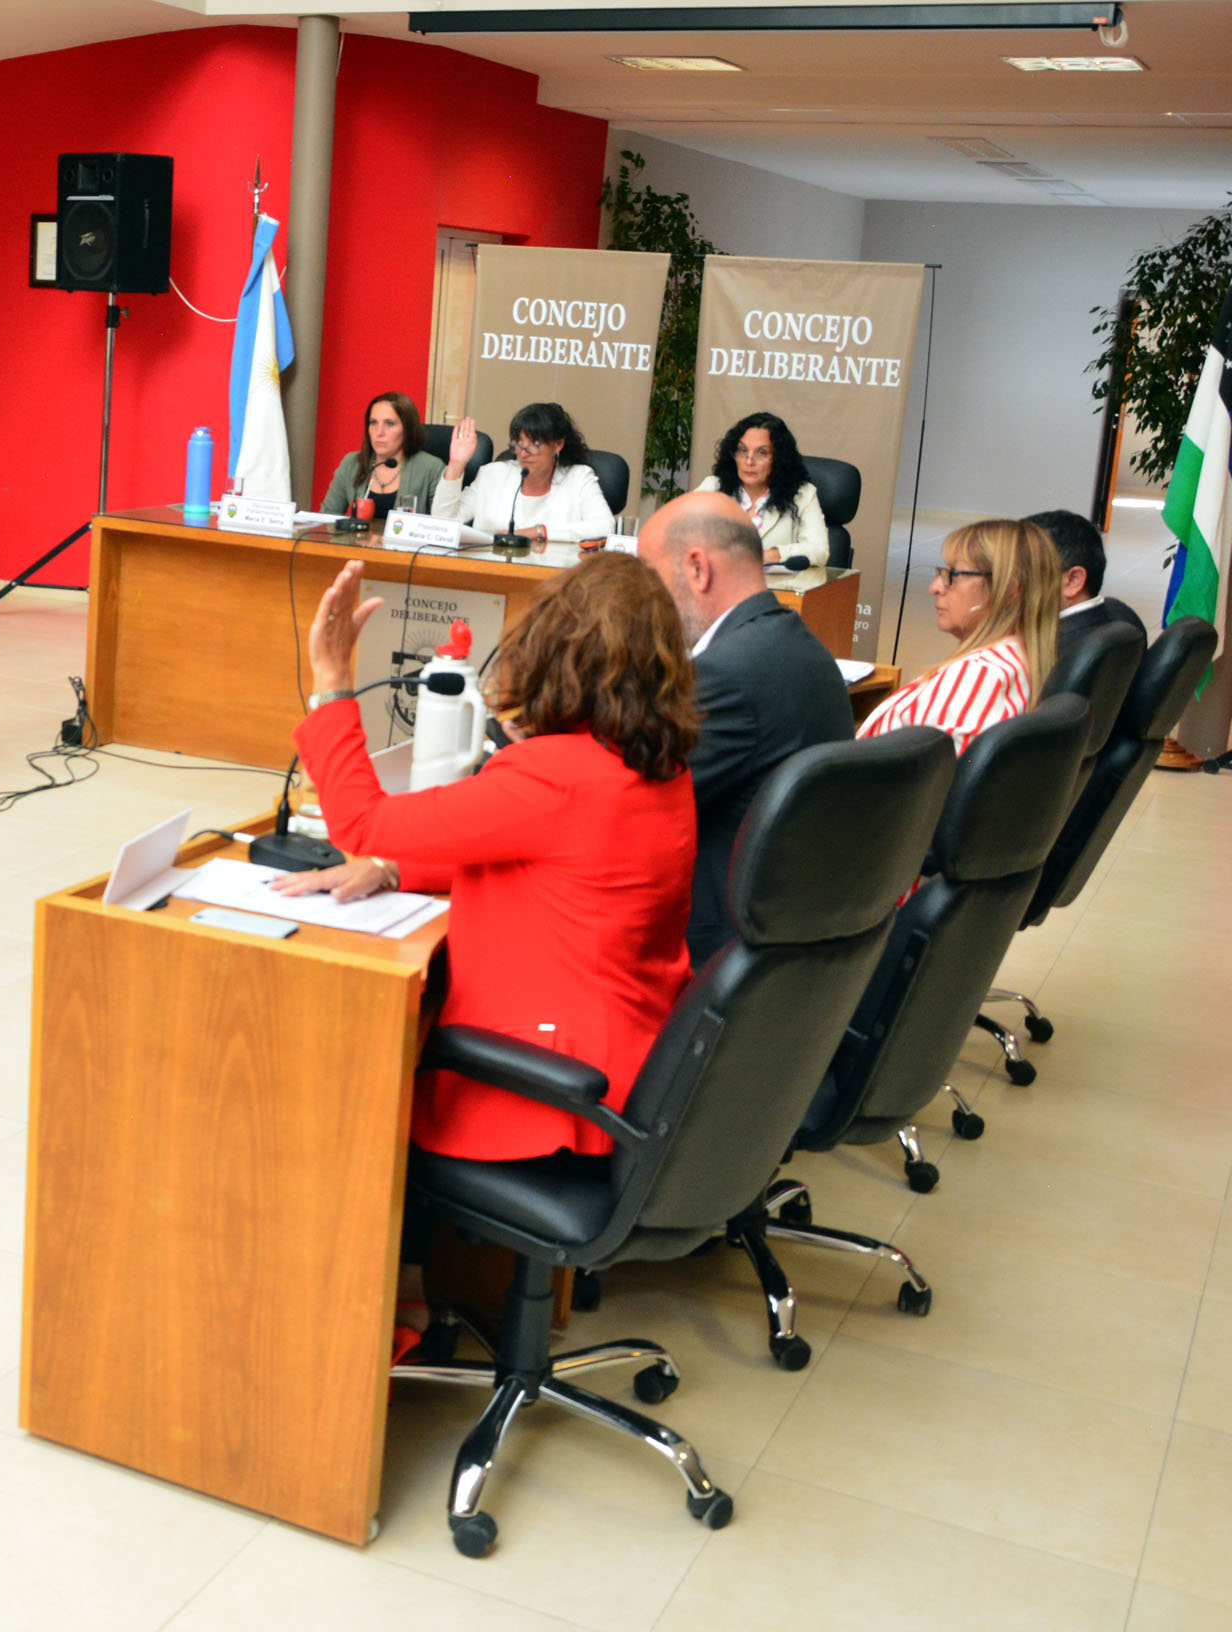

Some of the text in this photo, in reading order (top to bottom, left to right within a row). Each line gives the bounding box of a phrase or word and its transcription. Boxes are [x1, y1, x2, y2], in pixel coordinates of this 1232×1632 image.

[511, 296, 627, 338] CONCEJO
[743, 308, 873, 352] CONCEJO
[481, 331, 652, 372] DELIBERANTE
[708, 346, 902, 388] DELIBERANTE
[404, 597, 458, 613] CONCEJO
